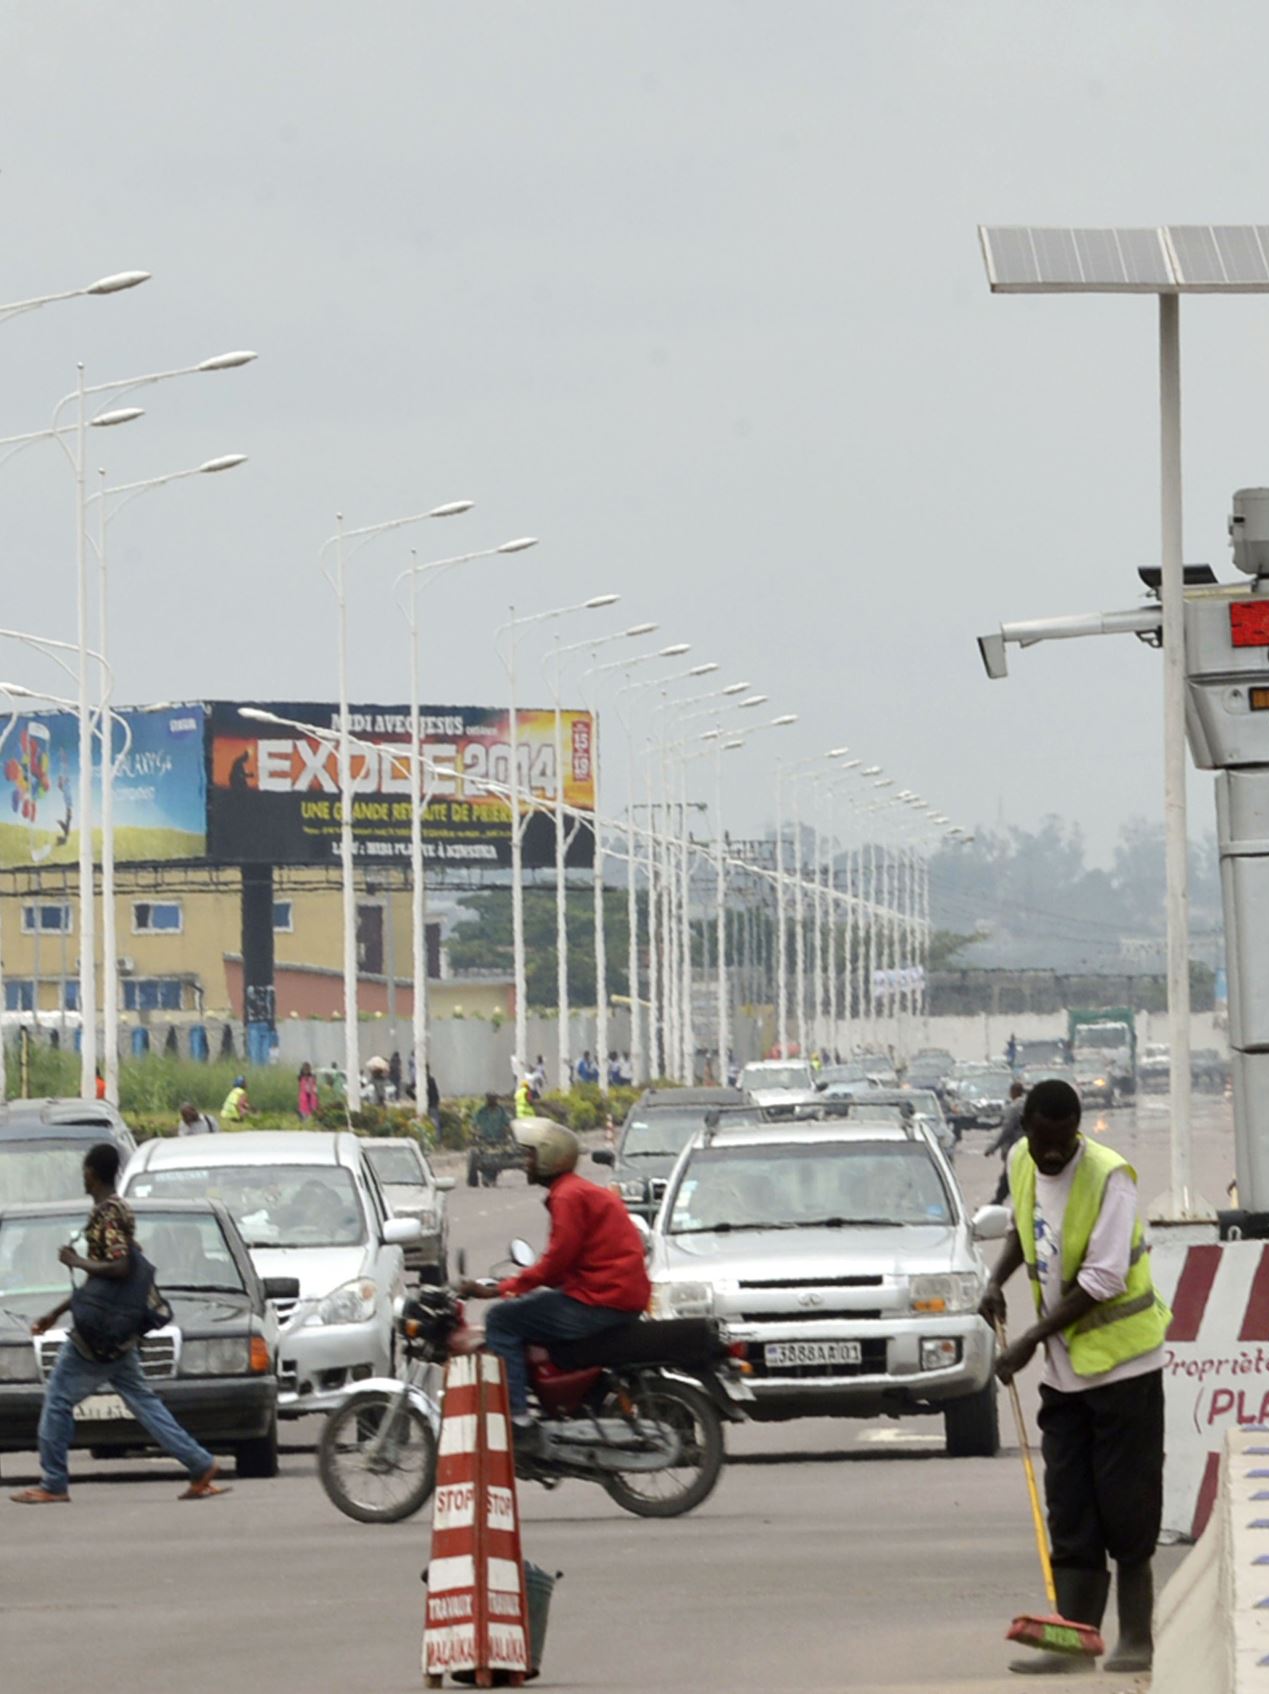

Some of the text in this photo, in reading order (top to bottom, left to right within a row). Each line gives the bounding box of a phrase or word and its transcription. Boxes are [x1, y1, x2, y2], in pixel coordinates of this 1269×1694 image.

[418, 715, 464, 738] JESUS
[257, 738, 557, 799] EXODE 2014
[301, 801, 331, 820] UNE
[333, 801, 389, 822] GANDE
[393, 802, 447, 822] RETAITE
[451, 802, 470, 822] DE
[437, 1488, 475, 1513] STOP
[487, 1493, 512, 1517] STOP
